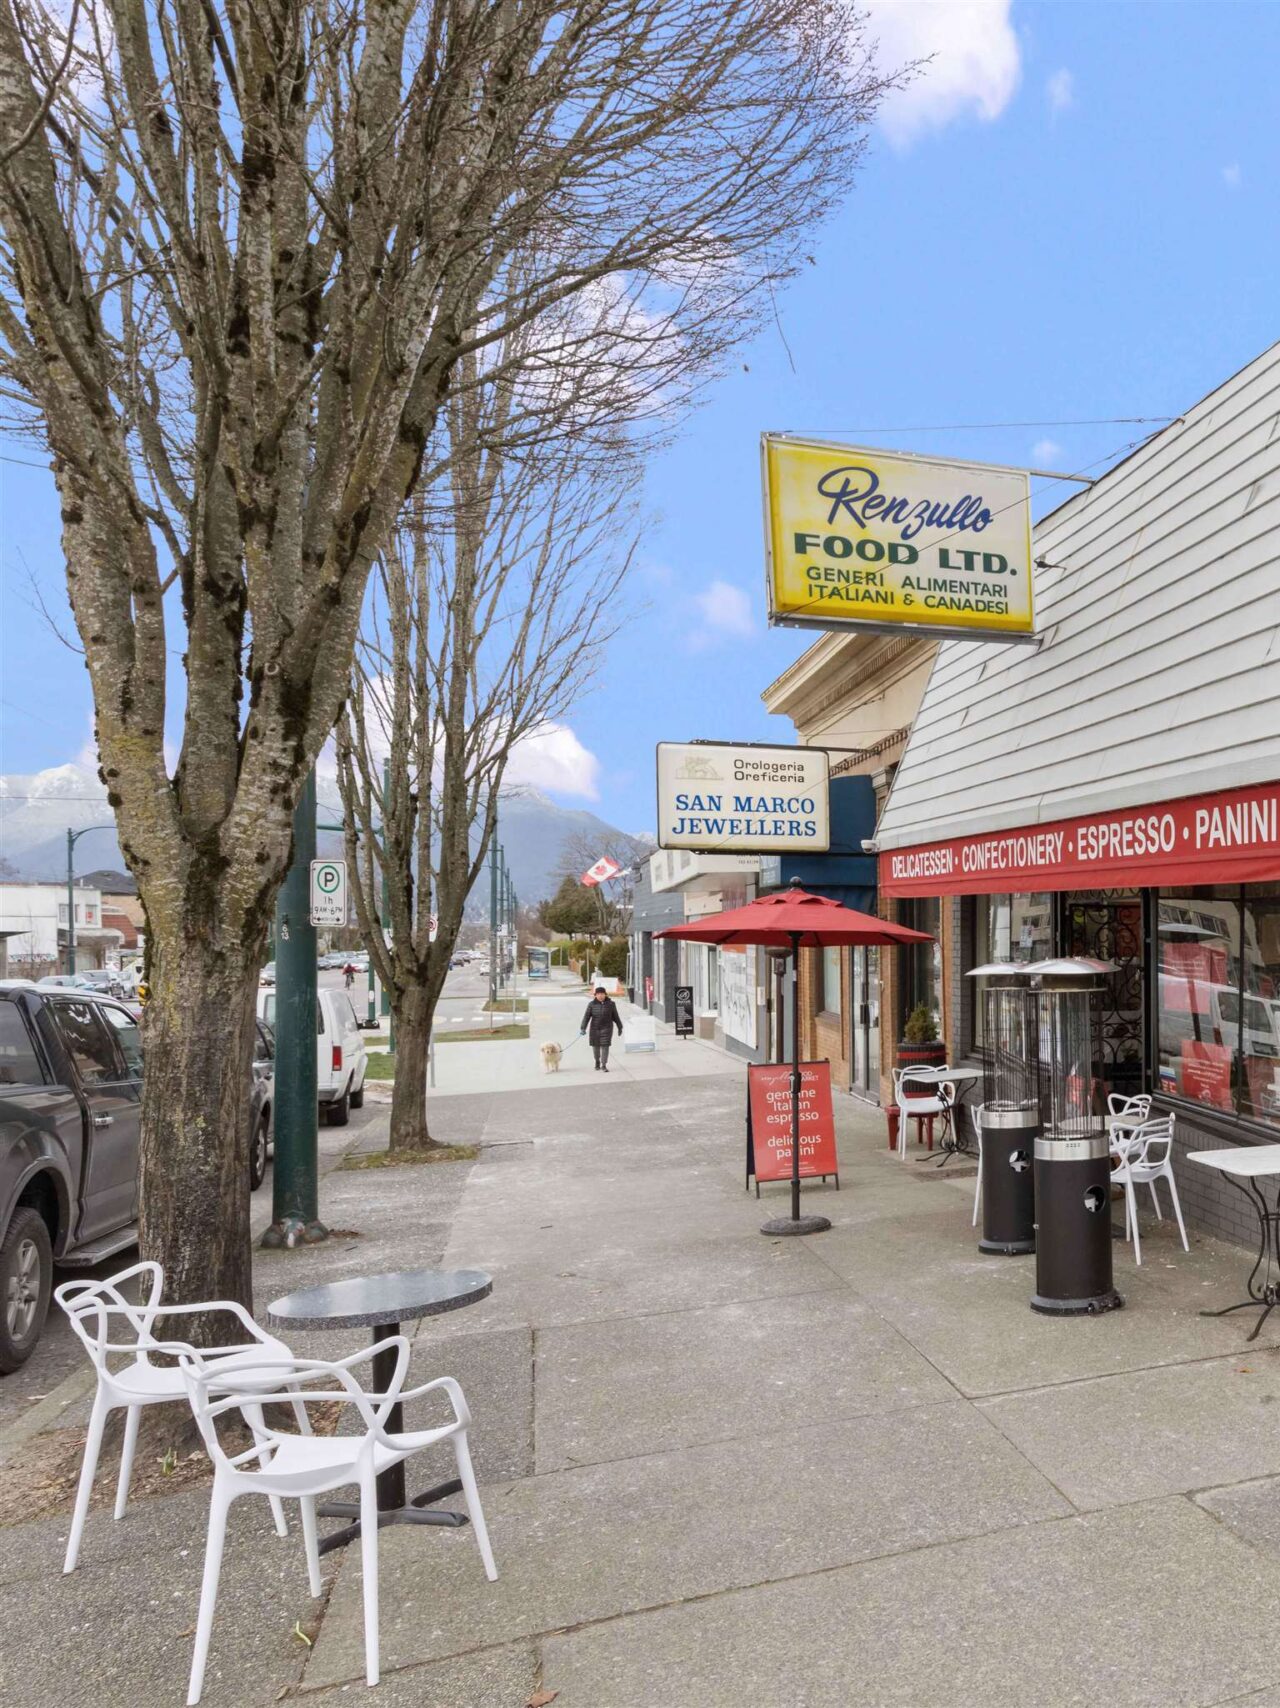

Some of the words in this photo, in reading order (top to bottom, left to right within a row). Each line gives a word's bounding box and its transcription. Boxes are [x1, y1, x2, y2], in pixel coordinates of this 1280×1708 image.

[817, 466, 994, 540] Renzullo
[794, 532, 919, 565] FOOD
[938, 547, 1018, 576] LTD.
[806, 566, 884, 587] GENERI
[901, 575, 1007, 598] ALIMENTARI
[808, 584, 894, 604] ITALIANI
[903, 593, 915, 606] &
[924, 595, 1009, 615] CANADESI
[733, 759, 805, 773] Orologeria
[734, 771, 805, 783] Oreficeria
[676, 794, 723, 812] SAN
[733, 796, 815, 814] MARCO
[672, 818, 817, 837] JEWELLERS
[892, 848, 953, 879] DELICATESSEN
[961, 831, 1065, 872] CONFECTIONERY
[1077, 814, 1176, 861] ESPRESSO
[1195, 798, 1278, 849] PANINI
[324, 872, 335, 887] P
[766, 1088, 816, 1103] genine
[773, 1099, 811, 1112] Italan
[766, 1111, 819, 1125] esprsso
[767, 1134, 822, 1147] delicous
[776, 1144, 815, 1160] paini
